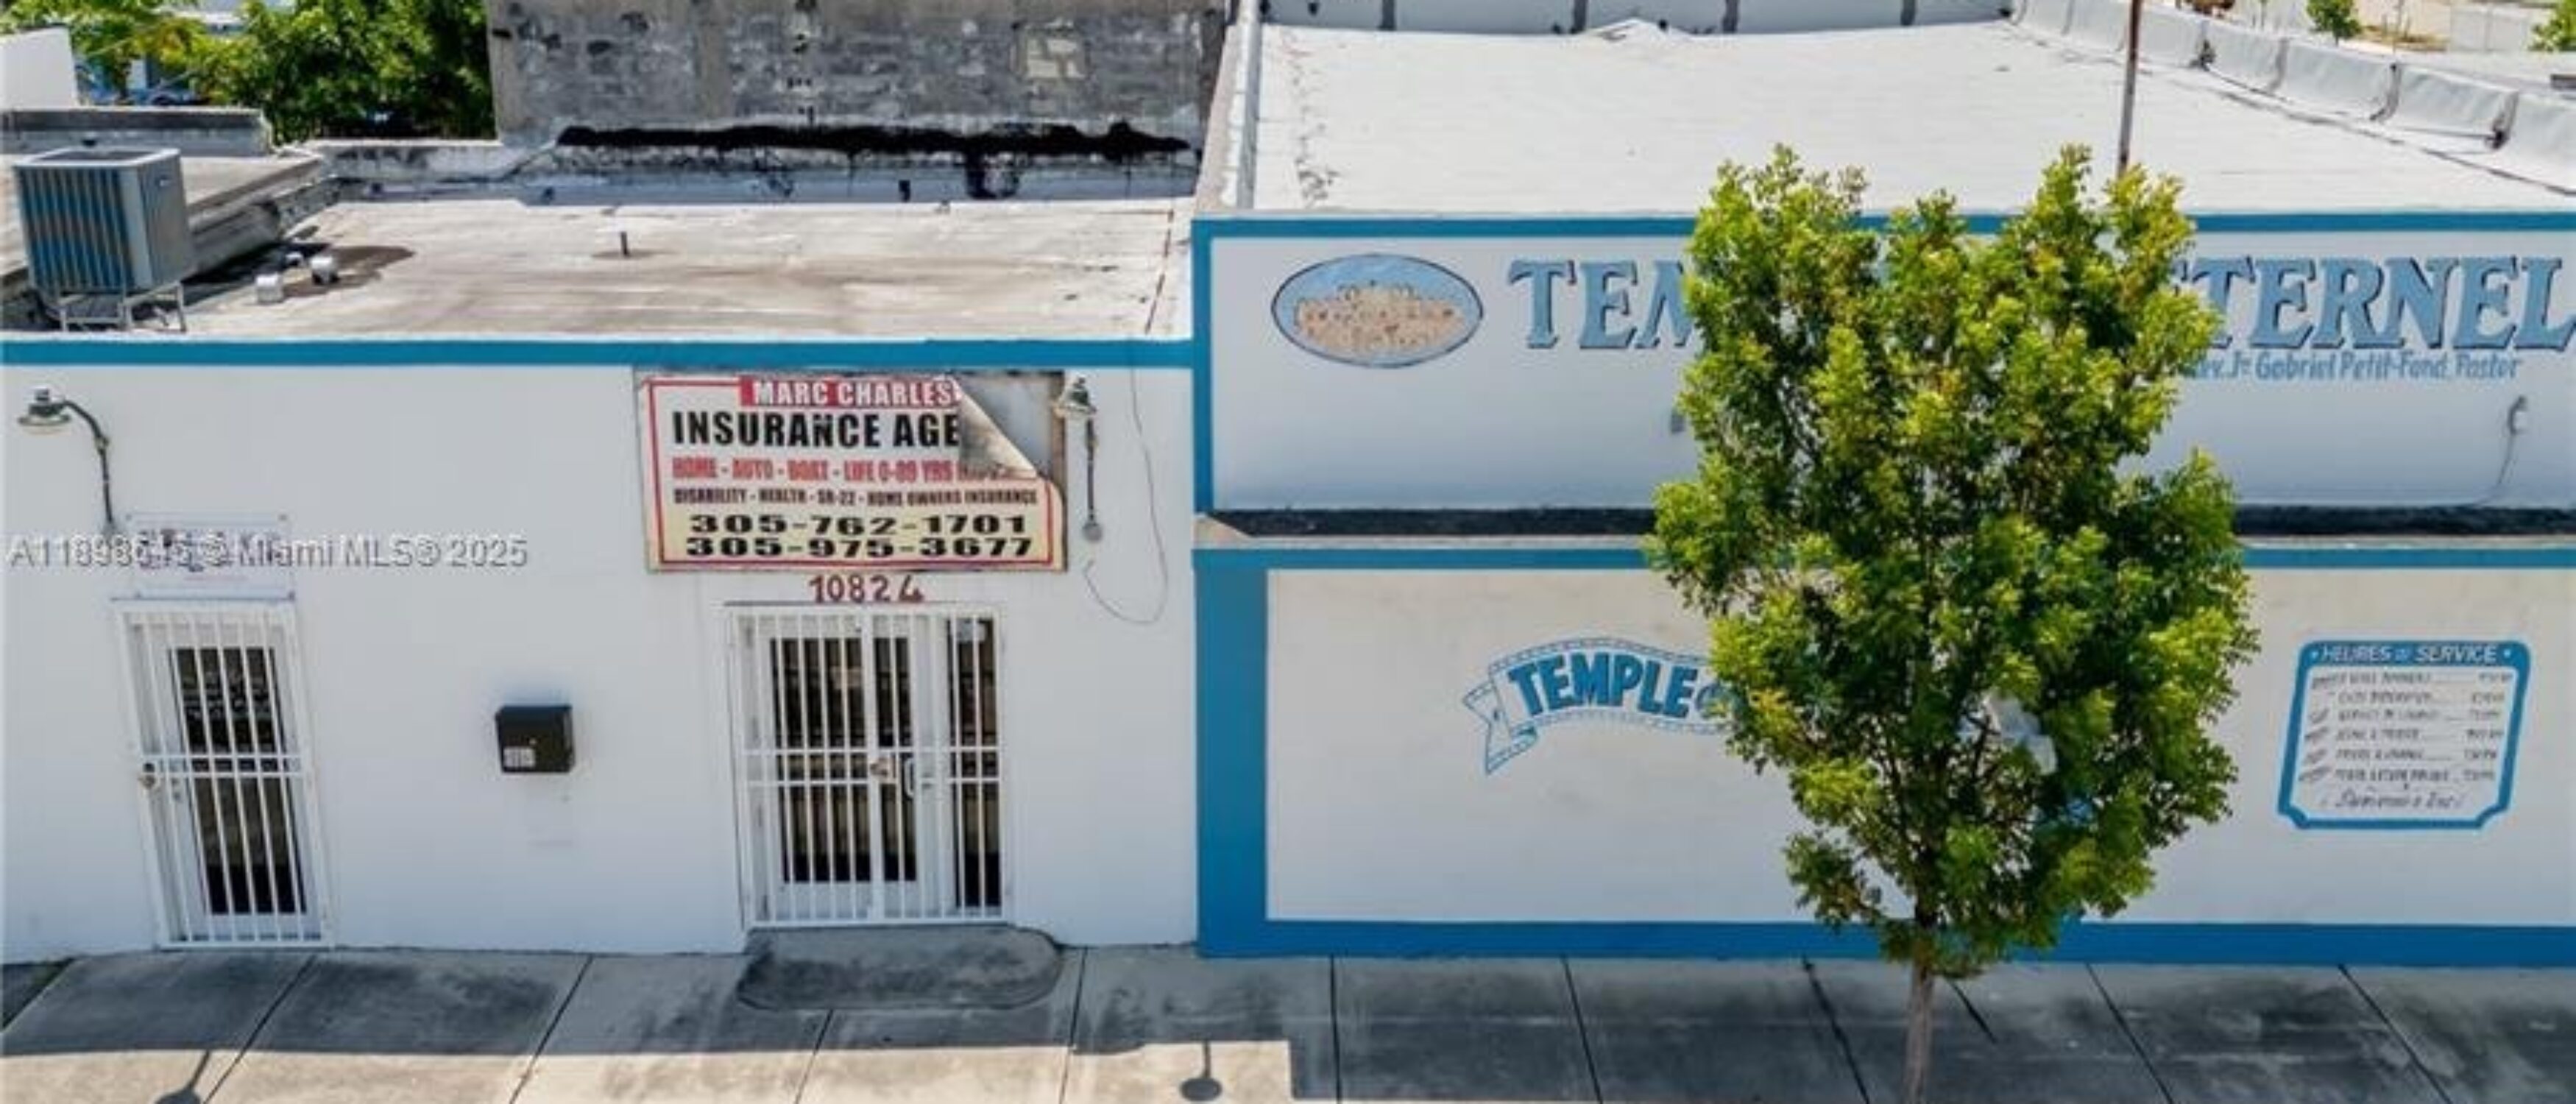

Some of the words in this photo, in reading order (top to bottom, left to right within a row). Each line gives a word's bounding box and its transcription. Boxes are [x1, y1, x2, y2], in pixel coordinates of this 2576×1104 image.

[2171, 256, 2576, 351] TERNEL
[753, 379, 828, 406] MARC
[837, 379, 955, 406] CHARLES
[673, 410, 880, 448] INSURANCE
[893, 413, 959, 447] AGE
[733, 458, 773, 480] AUTO
[844, 460, 874, 481] LIFE
[674, 489, 746, 503] DISABILITY
[759, 489, 806, 503] HEALTH
[868, 491, 902, 506] HOME
[907, 490, 961, 506] OWNERS
[964, 489, 1037, 504] INSURANCE
[692, 514, 1025, 535] 305-762-1701
[687, 537, 1032, 557] 305-975-3677
[810, 576, 924, 604] 10824
[2321, 645, 2391, 662] HEURES
[2416, 645, 2498, 662] SERVICE
[1509, 651, 1697, 718] TEMPLE
